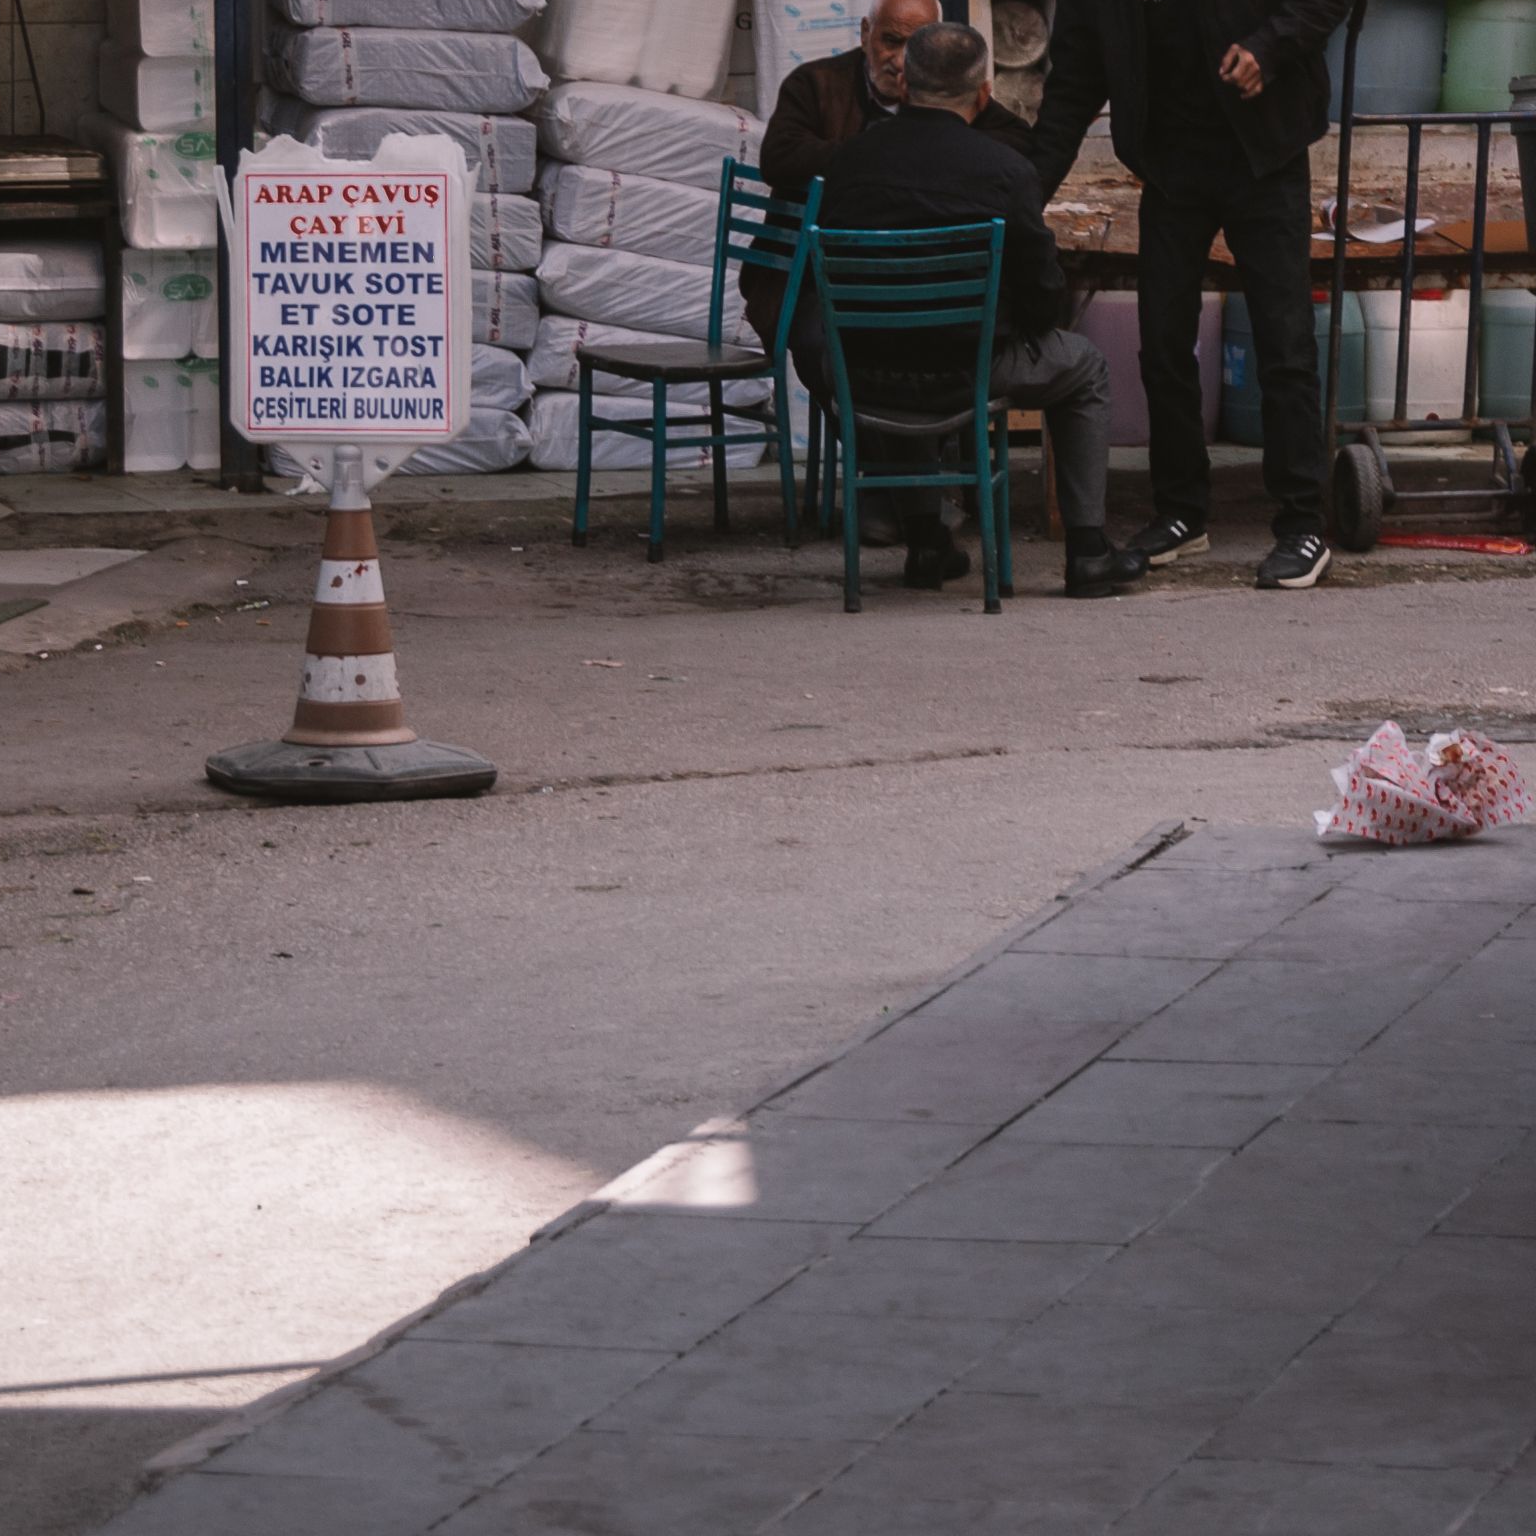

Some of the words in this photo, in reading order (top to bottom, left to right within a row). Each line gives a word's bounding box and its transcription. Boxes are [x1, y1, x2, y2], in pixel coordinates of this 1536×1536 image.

[254, 184, 333, 204] ARAP
[342, 184, 440, 208] ÇAVUŞ
[290, 215, 348, 239] ÇAY
[358, 210, 406, 234] EVİ
[260, 242, 435, 264] MENEMEN
[252, 272, 355, 295] TAVUK
[365, 272, 444, 295] SOTE
[280, 304, 320, 326] ET
[331, 304, 416, 326] SOTE
[252, 335, 364, 363] KARIŞIK
[373, 335, 444, 358] TOST
[260, 366, 334, 388] BALIK
[343, 366, 437, 389] IZGARA
[252, 391, 347, 425] ÇEŞİTLERİ
[354, 397, 444, 420] BULUNUR
